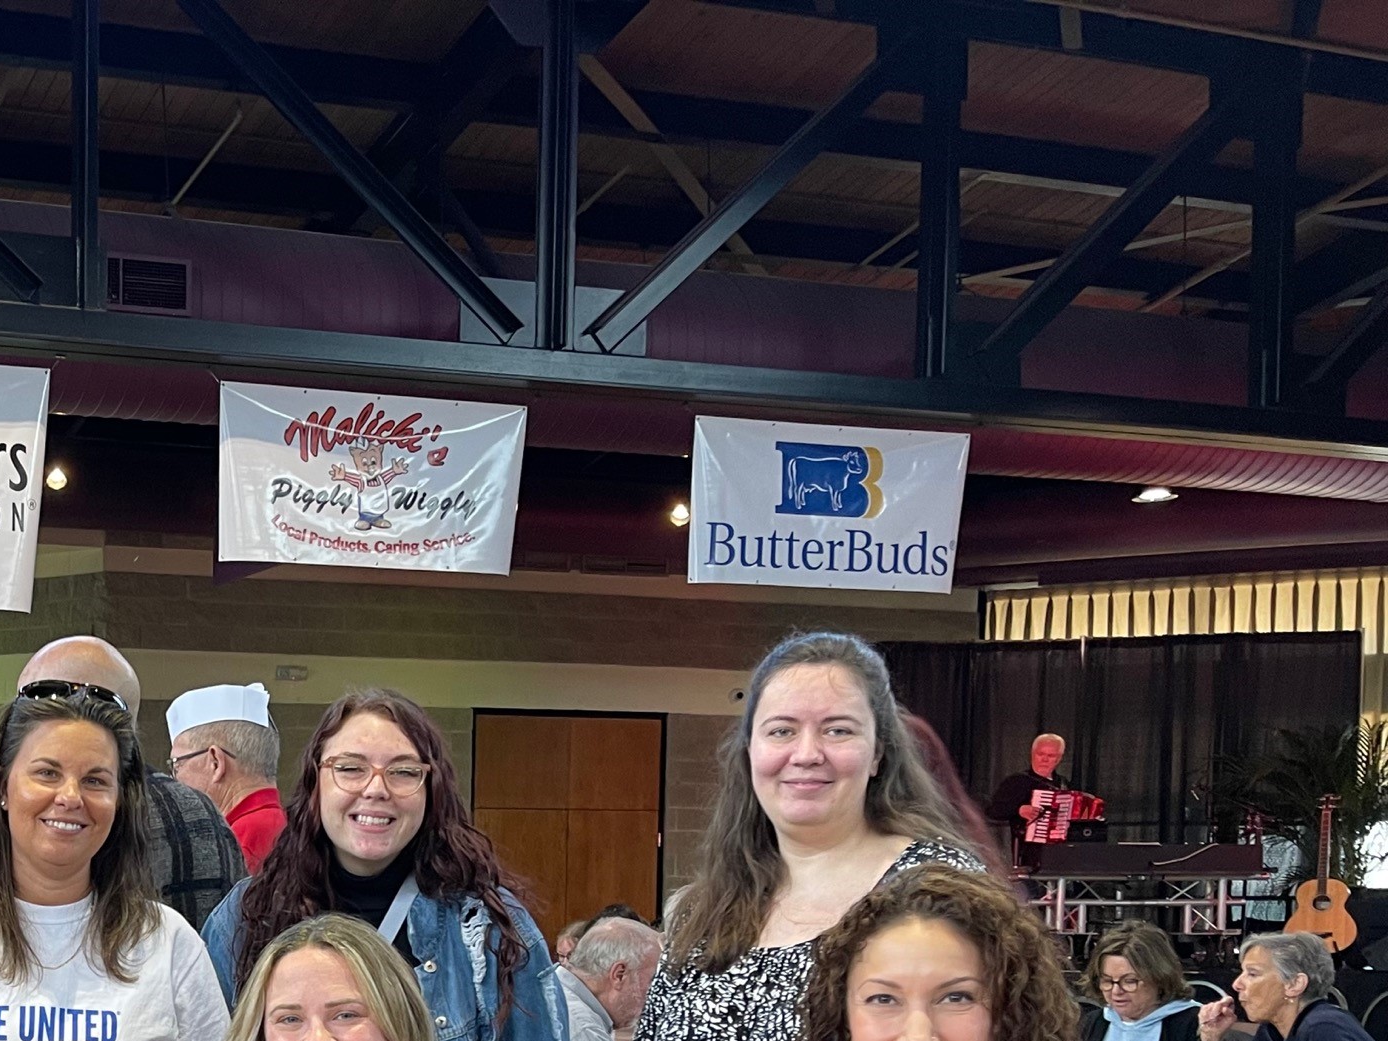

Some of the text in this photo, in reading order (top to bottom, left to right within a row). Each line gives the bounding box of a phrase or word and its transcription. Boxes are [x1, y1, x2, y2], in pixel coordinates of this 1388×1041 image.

[271, 477, 478, 520] Piggly Wiggly
[271, 513, 307, 542] Local
[374, 540, 419, 556] Caring
[704, 521, 949, 576] ButterBuds
